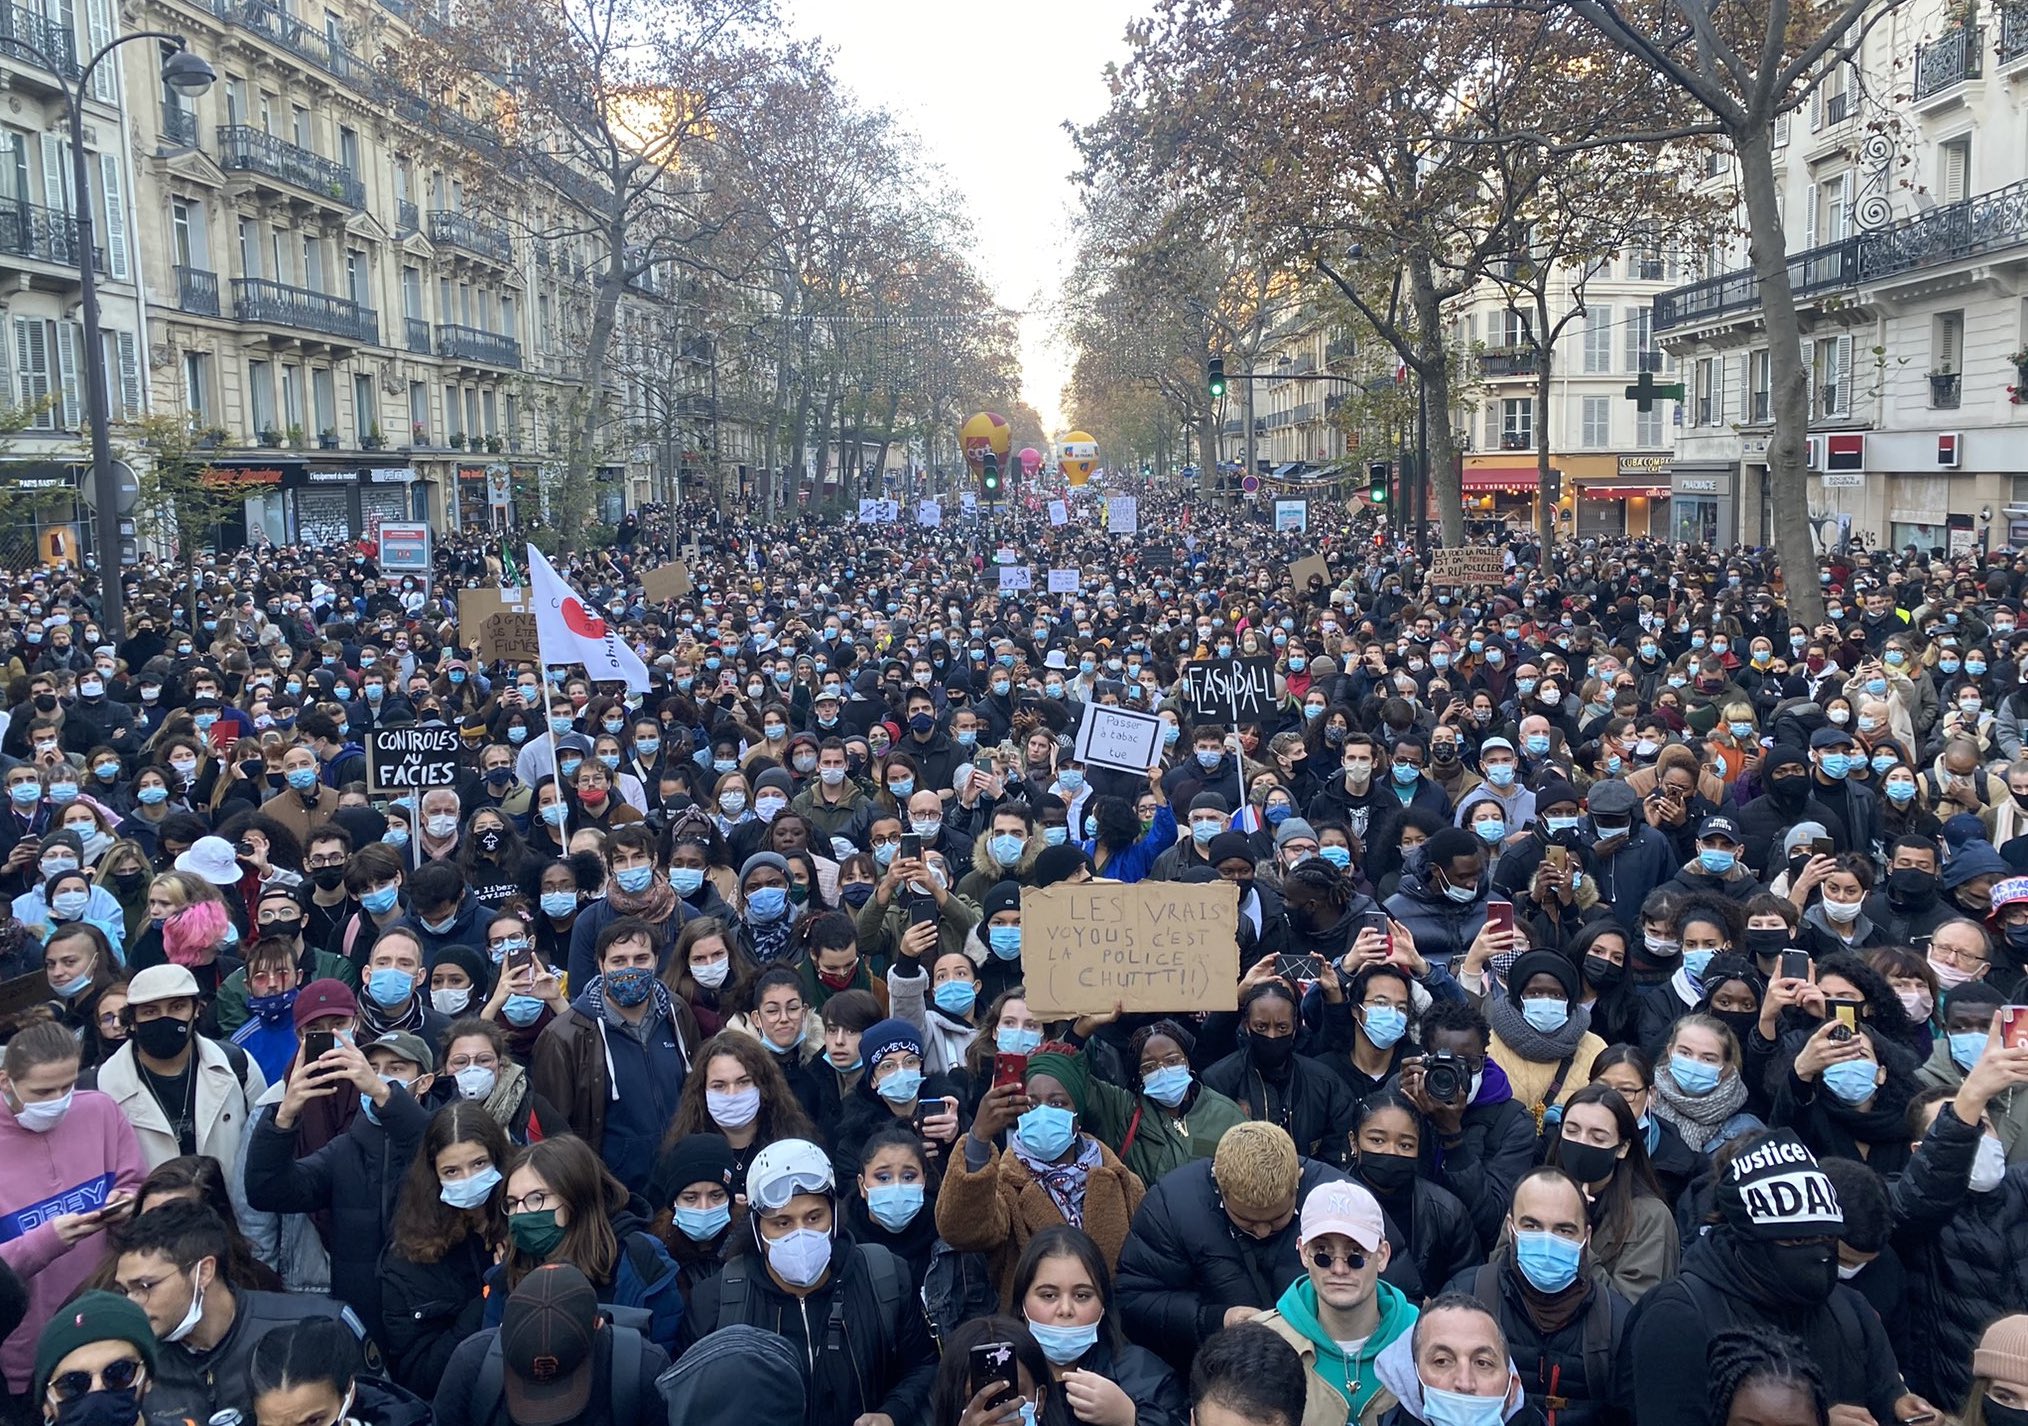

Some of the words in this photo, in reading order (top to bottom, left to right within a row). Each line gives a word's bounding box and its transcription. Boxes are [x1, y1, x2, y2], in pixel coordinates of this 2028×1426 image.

[1622, 457, 1642, 467] CUBA
[1188, 660, 1277, 722] FLASHBALL
[1106, 714, 1143, 730] Passer
[377, 729, 458, 751] CONTRÔLES
[1109, 730, 1138, 744] tabac
[403, 753, 422, 765] AU
[1109, 747, 1127, 760] tue
[380, 762, 455, 786] FACIES
[1070, 896, 1123, 923] LES
[1144, 901, 1221, 923] VRAIS
[1047, 926, 1134, 948] VOYOUS
[1152, 928, 1210, 947] C'EST
[1049, 949, 1072, 961] LA
[1731, 1140, 1807, 1182] Justice
